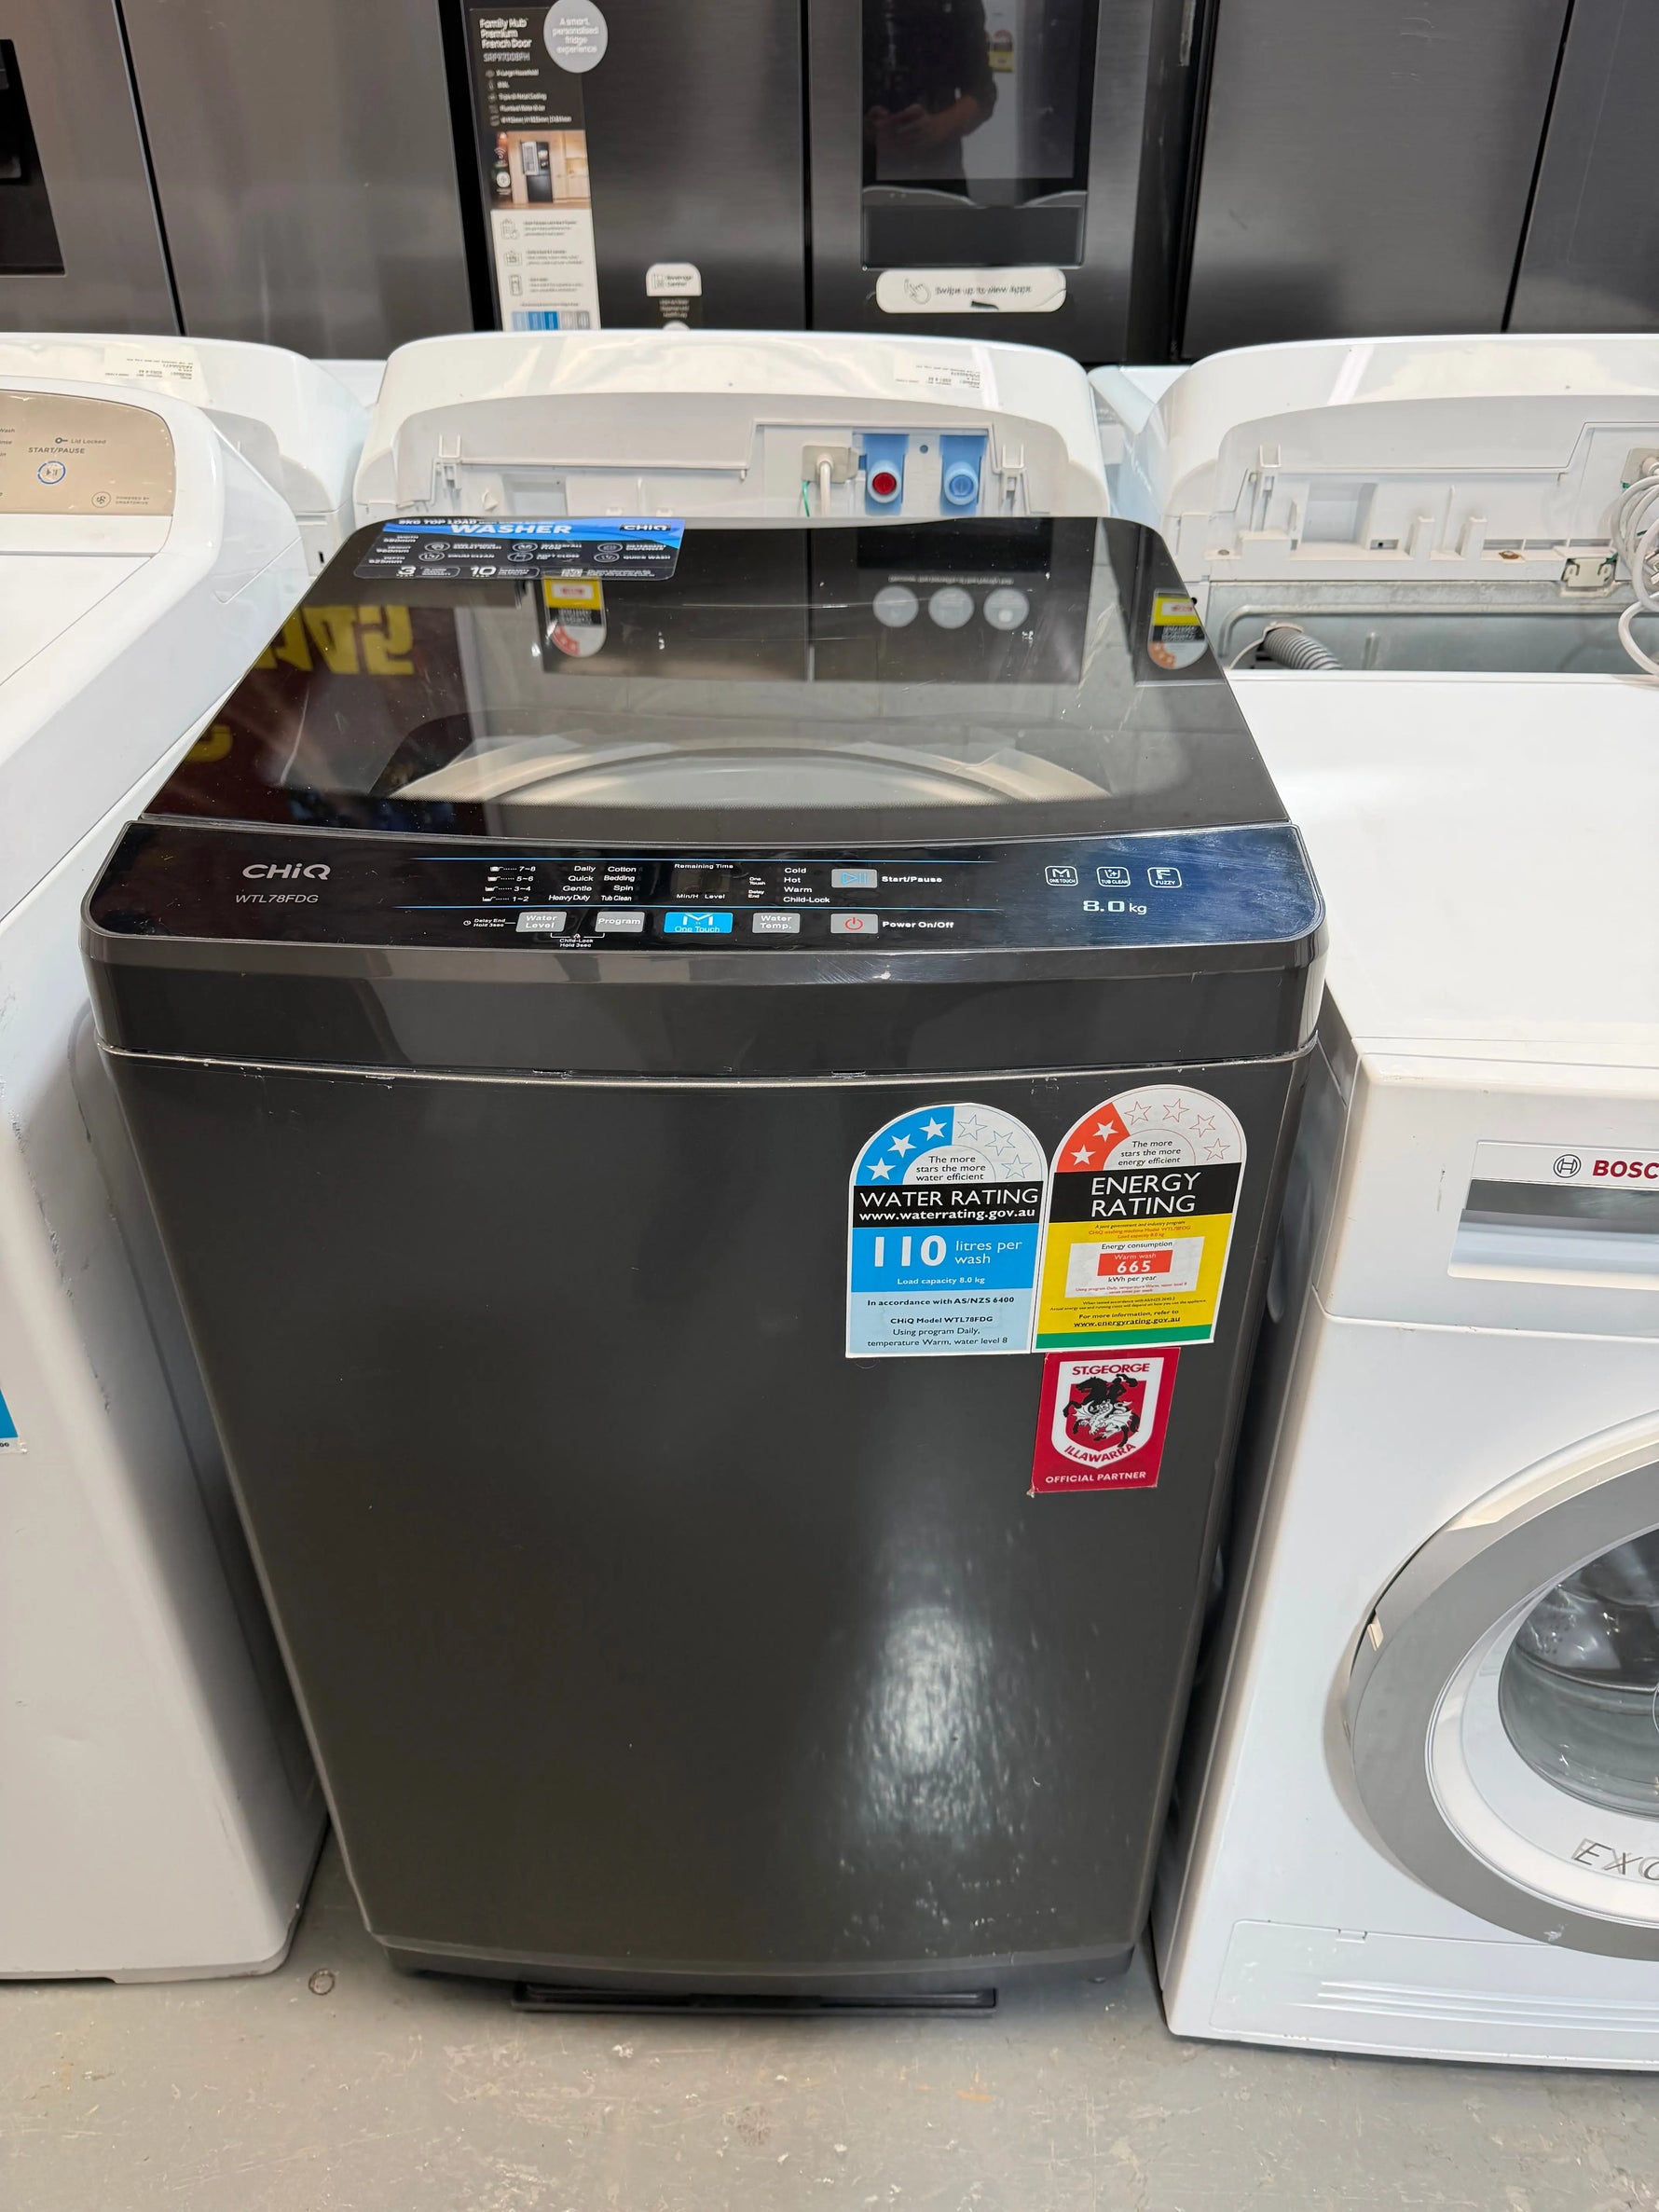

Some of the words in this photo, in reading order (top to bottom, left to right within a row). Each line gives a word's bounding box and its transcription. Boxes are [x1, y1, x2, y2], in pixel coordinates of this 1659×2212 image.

[479, 19, 508, 30] Family
[481, 30, 518, 38] Premium
[451, 524, 572, 534] WASHER
[399, 566, 417, 575] 3
[470, 566, 497, 575] 10
[242, 863, 331, 880] CHiQ
[236, 894, 319, 903] WTL78FDG
[1083, 900, 1125, 913] 8.0
[1130, 902, 1147, 915] kg
[598, 917, 641, 926] Program
[1131, 1140, 1147, 1148] The
[1120, 1149, 1141, 1158] stars
[928, 1155, 947, 1163] The
[1118, 1159, 1145, 1167] energy
[1091, 1172, 1200, 1196] ENERGY
[859, 1190, 942, 1208] WATER
[951, 1188, 1039, 1206] RATING
[1091, 1195, 1196, 1217] RATING
[859, 1209, 1035, 1221] www.waterrating.gov.au
[955, 1240, 992, 1252] litres
[997, 1241, 1022, 1254] per
[1127, 1241, 1172, 1249] consumption
[874, 1235, 947, 1268] 110
[954, 1253, 991, 1265] wash
[1117, 1259, 1151, 1273] 665
[922, 1278, 957, 1286] capacity
[975, 1277, 985, 1285] kg
[953, 1297, 991, 1305] AS/NZS
[1074, 1317, 1181, 1327] www.energyrating.gov.au
[893, 1328, 916, 1337] Using
[957, 1327, 980, 1336] Daily,
[980, 1337, 1000, 1345] level
[1072, 1363, 1150, 1376] ST.GEORGE
[1063, 1443, 1136, 1463] ILLAWARRA
[1046, 1474, 1094, 1484] OFFICIAL
[1097, 1471, 1146, 1481] PARTNER
